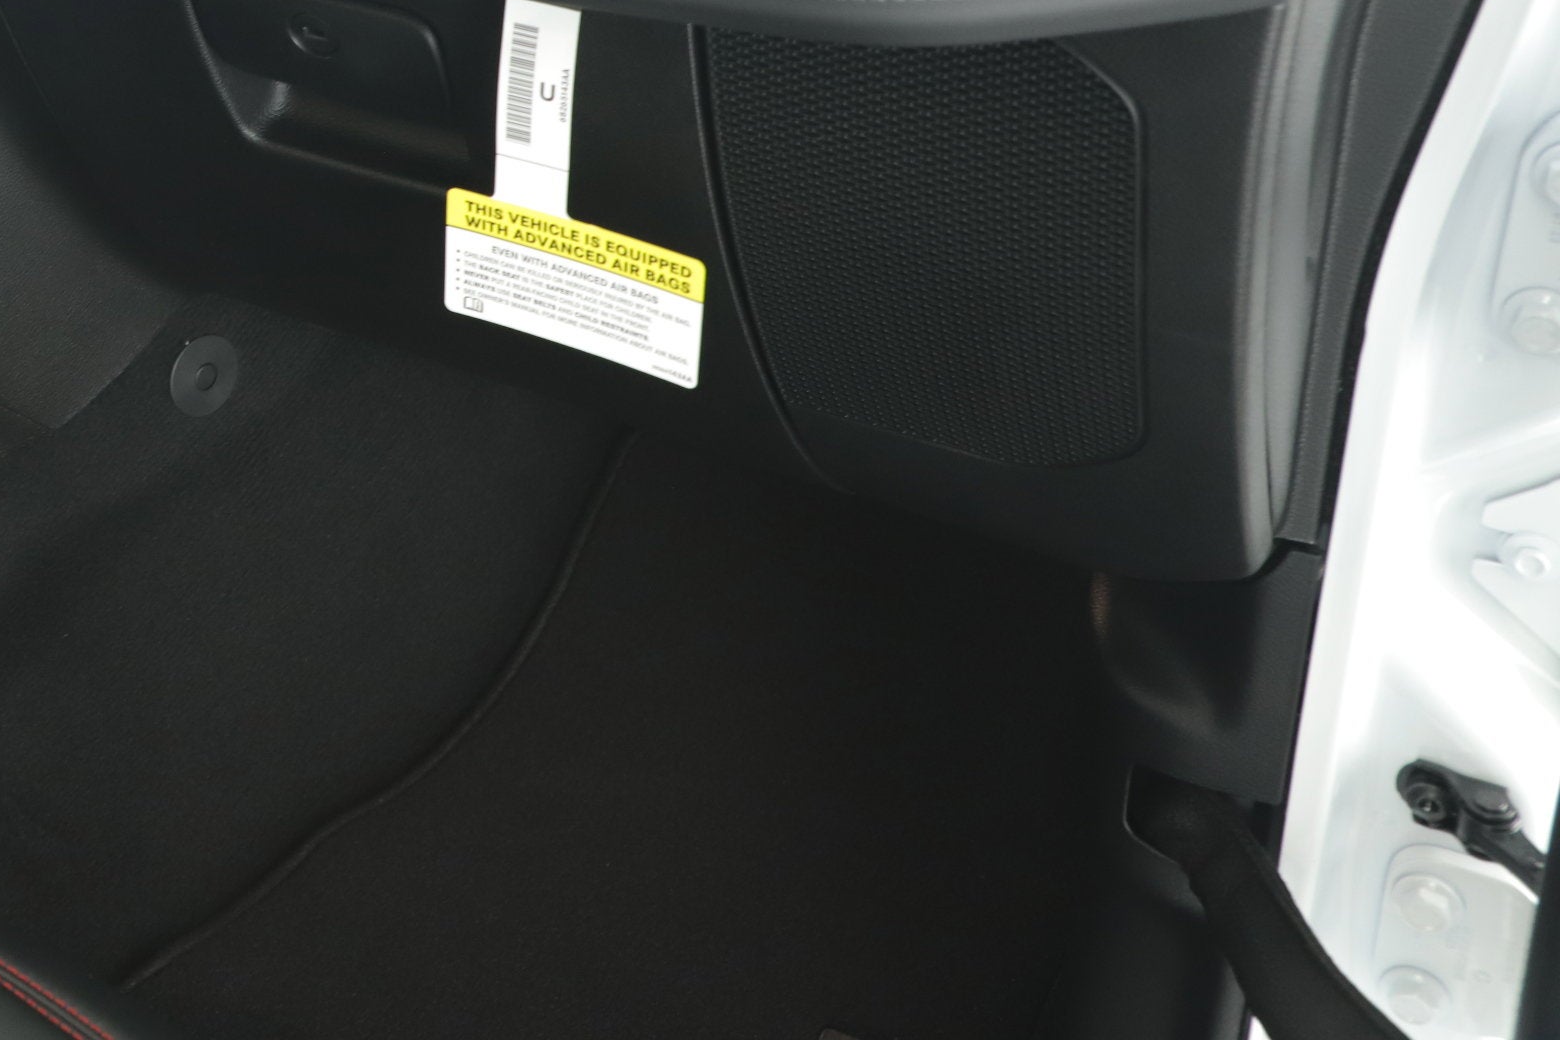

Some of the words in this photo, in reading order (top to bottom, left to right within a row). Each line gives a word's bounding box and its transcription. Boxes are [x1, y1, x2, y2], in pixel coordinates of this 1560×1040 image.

[465, 199, 503, 221] THIS
[508, 211, 579, 242] VEHICLE
[584, 233, 599, 248] IS
[605, 240, 691, 279] EQUIPPED
[465, 213, 507, 237] WITH
[513, 227, 607, 266] ADVANCED
[612, 257, 639, 277] AIR
[645, 268, 690, 294] BAGS
[492, 245, 517, 260] EVEN
[521, 253, 547, 269] WITH
[551, 262, 607, 287] ADVANCED
[610, 281, 627, 294] AIR
[630, 288, 658, 304] BAGS
